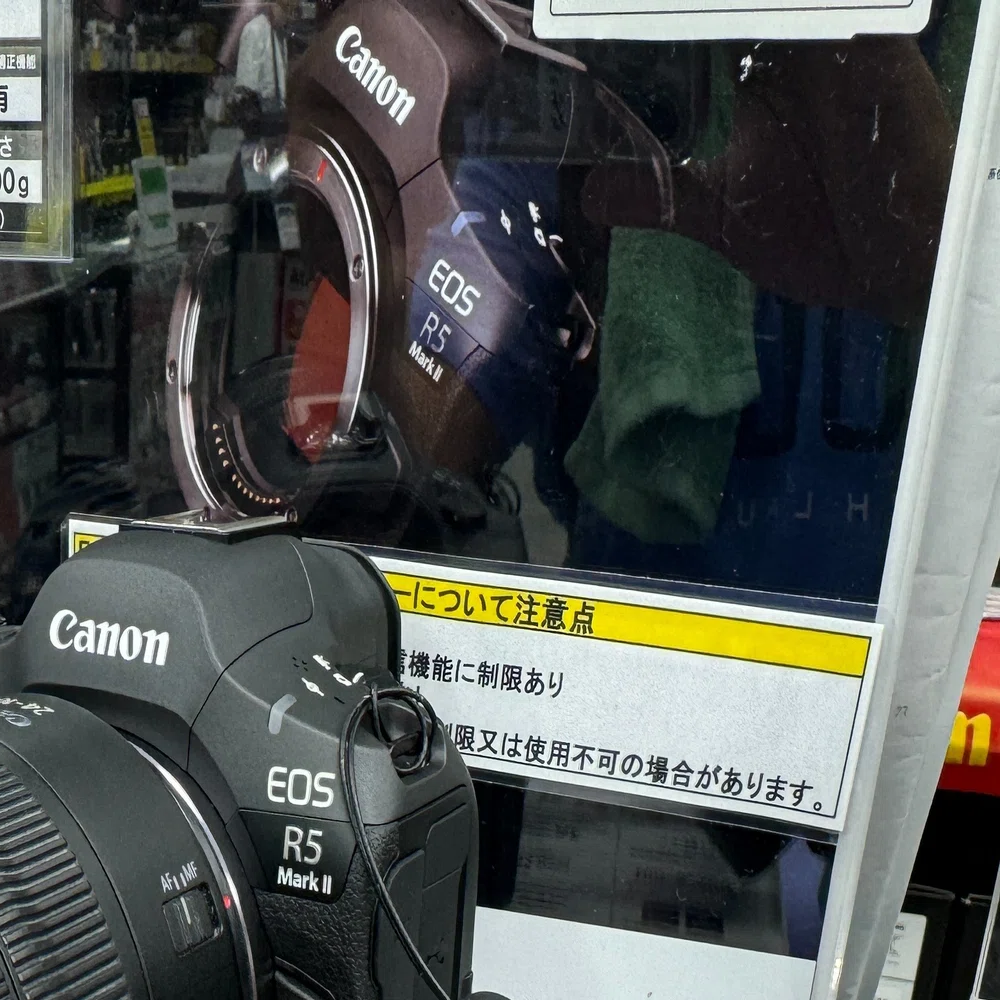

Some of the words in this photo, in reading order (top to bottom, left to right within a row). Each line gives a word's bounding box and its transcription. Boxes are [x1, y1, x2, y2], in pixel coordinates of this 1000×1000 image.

[336, 26, 416, 126] Canon
[428, 259, 481, 317] EOS
[420, 311, 452, 353] R5
[408, 341, 435, 376] Mark
[49, 609, 170, 667] Canon
[267, 766, 336, 808] EOS
[446, 723, 823, 813] 限又は使用不可の場合があります。
[282, 825, 324, 866] R5
[160, 875, 174, 893] AF
[183, 861, 198, 883] MF
[277, 866, 319, 893] Mark
[321, 872, 332, 895] II
